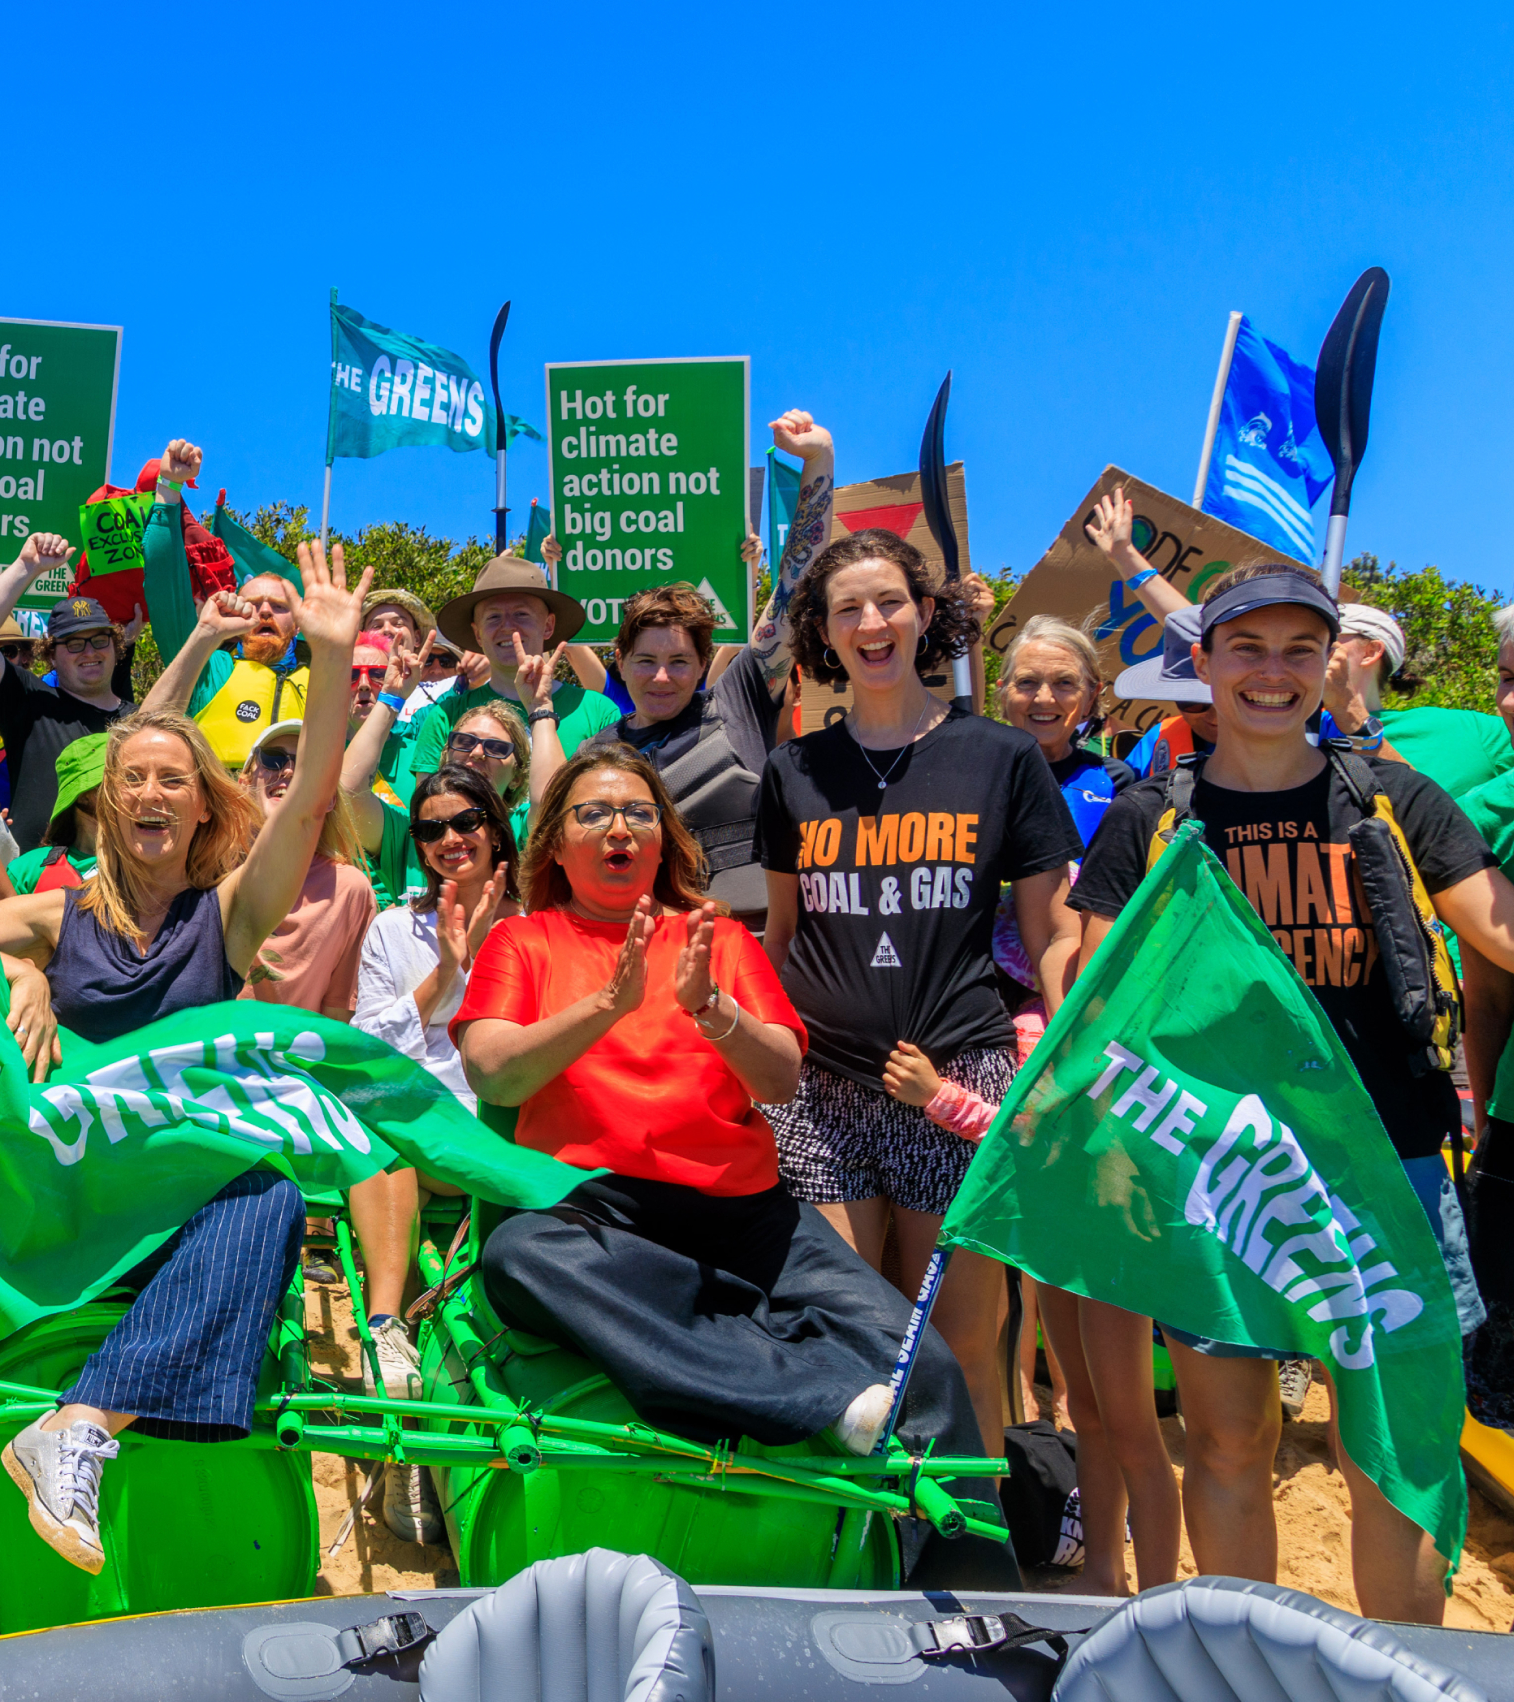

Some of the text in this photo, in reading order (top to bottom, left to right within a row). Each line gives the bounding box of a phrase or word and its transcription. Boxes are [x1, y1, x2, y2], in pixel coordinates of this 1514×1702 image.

[331, 354, 484, 437] HE GREENS
[559, 384, 670, 421] Hot for
[32, 434, 83, 466] not
[561, 426, 679, 459] climate
[562, 464, 721, 499] action not
[564, 501, 684, 542] big coal
[88, 530, 143, 551] EXCLUS
[104, 546, 144, 564] ZON
[565, 541, 674, 572] donors
[47, 566, 67, 580] THE
[236, 710, 257, 720] COAL
[797, 811, 979, 870] NO MORE
[1224, 821, 1319, 844] THIS IS A
[799, 866, 974, 916] COAL & GAS
[1086, 1040, 1209, 1158] THE
[897, 1307, 924, 1364] SEAM
